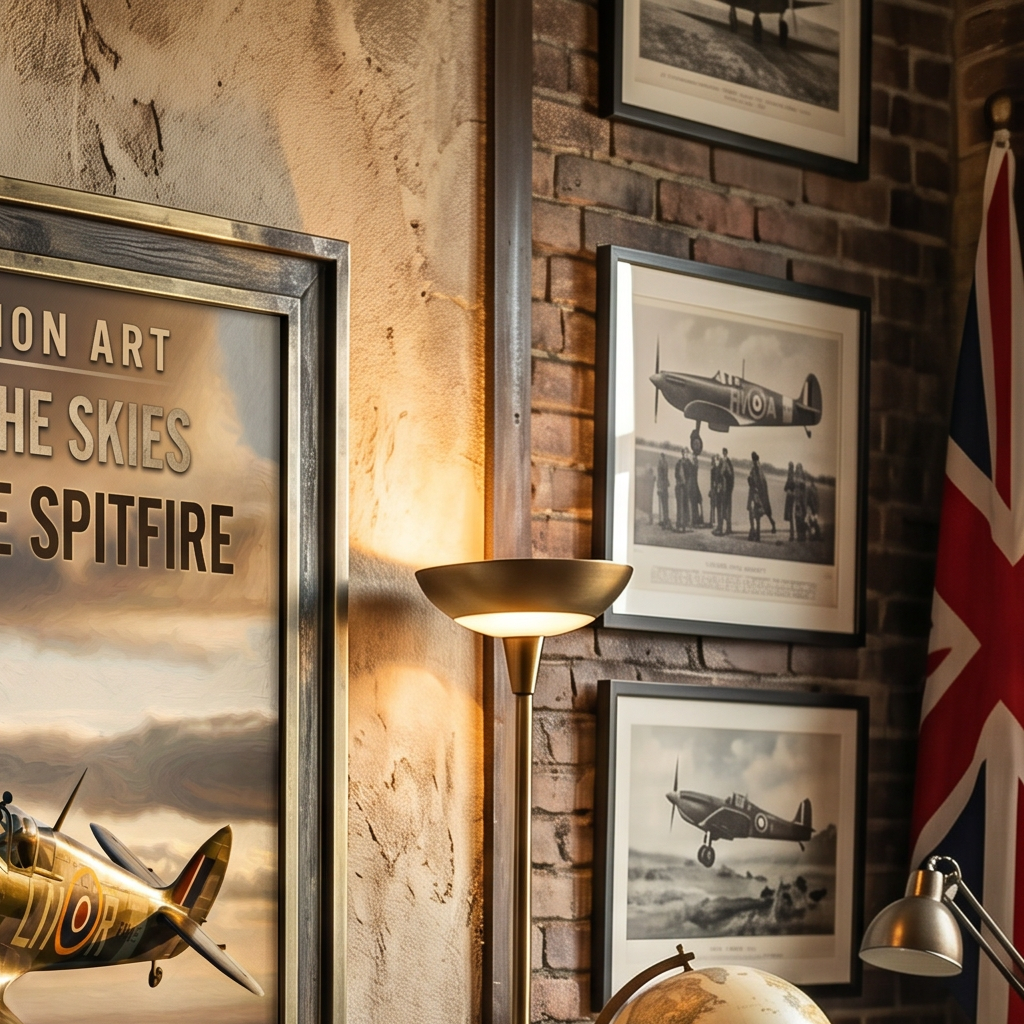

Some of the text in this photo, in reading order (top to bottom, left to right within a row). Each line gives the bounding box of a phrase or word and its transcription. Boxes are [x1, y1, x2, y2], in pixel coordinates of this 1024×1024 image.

[90, 319, 171, 372] ART
[68, 394, 193, 474] SKIES
[29, 485, 235, 575] SPITFIRE
